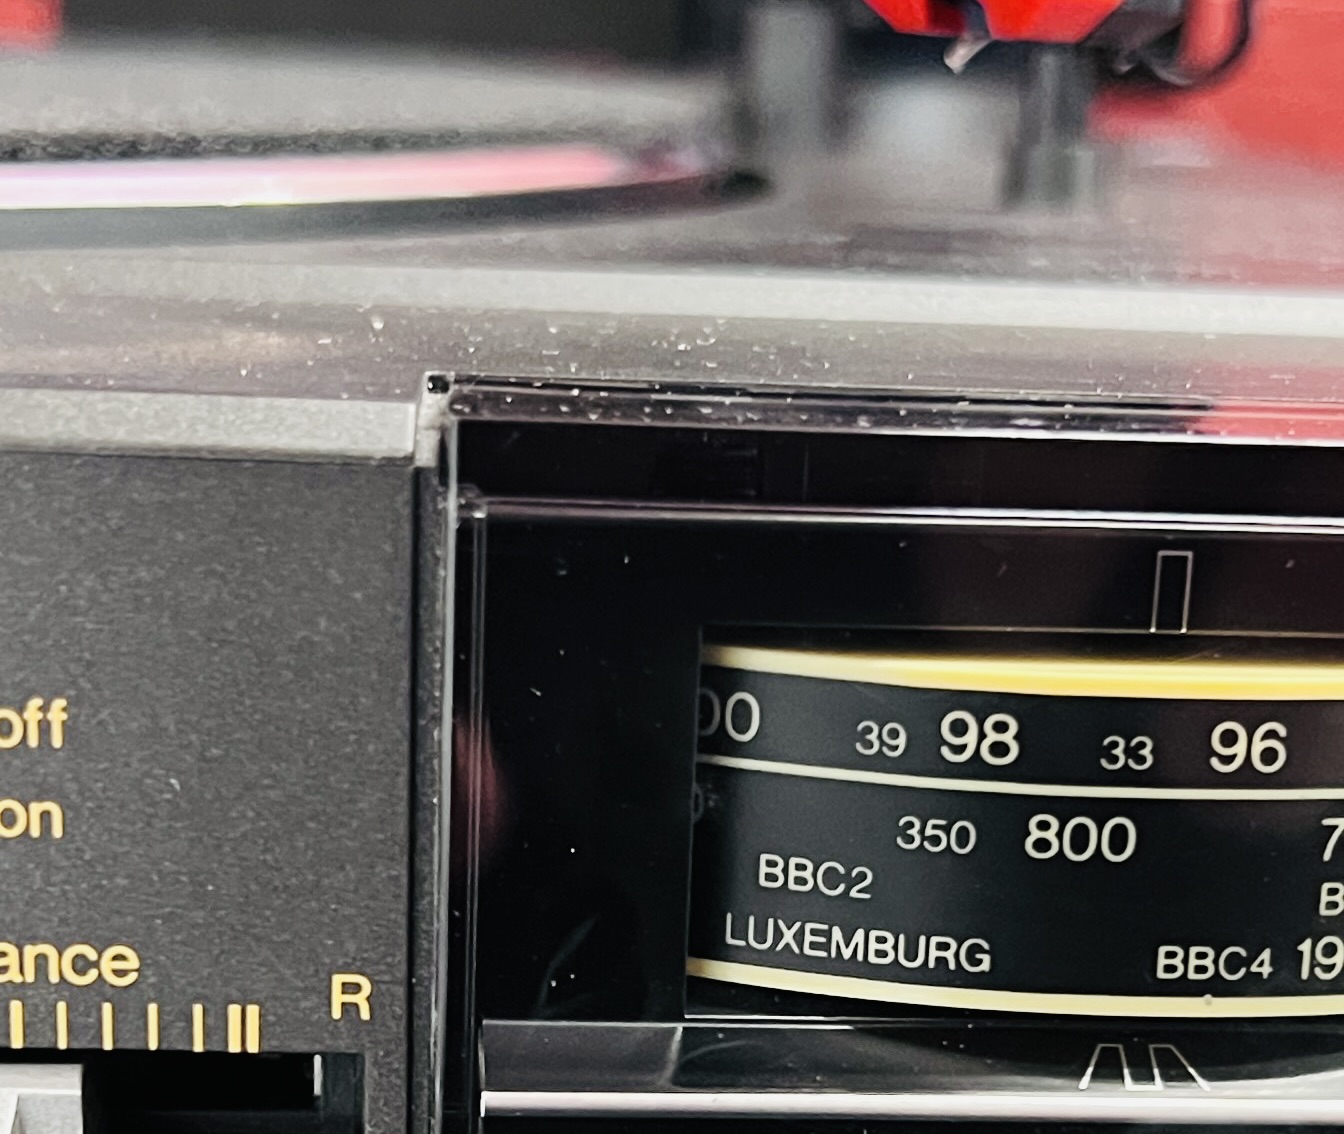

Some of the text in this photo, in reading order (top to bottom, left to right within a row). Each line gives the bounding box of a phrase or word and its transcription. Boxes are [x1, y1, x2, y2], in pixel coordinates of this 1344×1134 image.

[855, 720, 907, 758] 39
[939, 710, 1020, 766] 98
[1100, 735, 1154, 771] 33
[1208, 720, 1288, 774] 96
[896, 816, 977, 855] 350
[1024, 813, 1137, 863] 800
[758, 852, 874, 899] BBC2
[725, 912, 992, 973] LUXEMBURG
[1156, 945, 1274, 981] BBC4
[330, 974, 372, 1020] R
